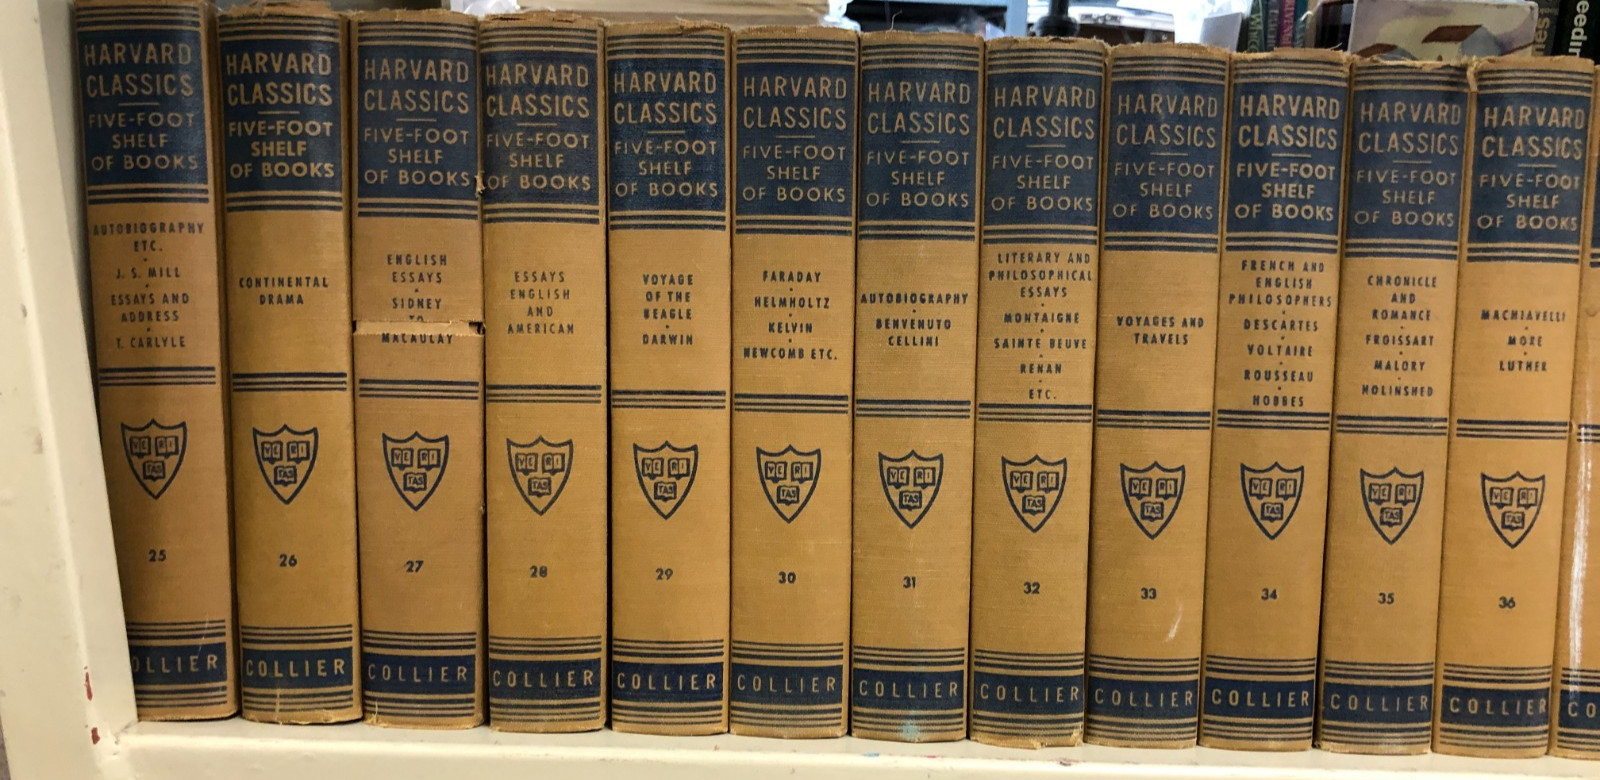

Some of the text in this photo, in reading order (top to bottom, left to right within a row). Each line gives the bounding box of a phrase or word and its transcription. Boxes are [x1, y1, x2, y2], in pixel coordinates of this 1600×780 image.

[85, 43, 192, 66] HARVARD
[227, 53, 331, 75] HARVARD
[366, 59, 468, 82] HARVARD
[487, 64, 588, 87] HARVARD
[615, 71, 716, 93] HARVARD
[87, 74, 194, 98] CLASSICS
[744, 76, 846, 98] HARVARD
[869, 81, 970, 104] HARVARD
[227, 82, 333, 106] CLASSICS
[365, 89, 469, 114] CLASSICS
[995, 86, 1095, 109] HARVARD
[487, 96, 589, 118] CLASSICS
[615, 102, 716, 125] CLASSICS
[1119, 94, 1217, 119] HARVARD
[1241, 94, 1339, 119] HARVARD
[1361, 101, 1460, 125] HARVARD
[744, 107, 846, 130] CLASSICS
[868, 112, 969, 135] CLASSICS
[1485, 107, 1584, 129] HARVARD
[994, 115, 1094, 140] CLASSICS
[365, 128, 469, 144] FIVE-FOOT
[1117, 124, 1216, 148] CLASSICS
[1239, 124, 1337, 150] CLASSICS
[252, 141, 306, 156] SHELF
[615, 140, 716, 155] FIVE-FOOT
[1359, 132, 1458, 156] CLASSICS
[1483, 136, 1582, 160] CLASSICS
[92, 154, 199, 171] OF BOOKS
[867, 150, 969, 165] FIVE-FOOT
[230, 162, 334, 178] OF BOOKS
[1357, 170, 1456, 185] FIVE-FOOT
[364, 170, 469, 186] OF BOOKS
[488, 175, 590, 191] OF BOOKS
[1018, 175, 1070, 189] SHELF
[616, 182, 717, 197] OF BOOKS
[743, 186, 845, 202] OF BOOKS
[1263, 183, 1314, 199] SHELF
[867, 192, 968, 207] OF BOOKS
[992, 196, 1092, 212] OF BOOKS
[1507, 194, 1558, 209] SHELF
[1113, 204, 1212, 220] OF BOOKS
[1235, 204, 1333, 221] OF BOOKS
[1354, 211, 1453, 227] OF BOOKS
[91, 222, 206, 237] AUTOBIOGRAPHY
[1477, 215, 1577, 231] OF BOOKS
[133, 240, 162, 252] ETC.
[386, 253, 447, 266] ENGLISH
[997, 251, 1090, 265] LITERARY AND
[147, 266, 182, 279] MILL
[1241, 259, 1325, 273] FRENCH AND
[238, 275, 329, 290] CONTINENTAL
[391, 271, 442, 284] ESSAYS
[513, 270, 565, 283] ESSAYS
[642, 273, 694, 286] VOYAGE
[762, 269, 821, 283] FARADAY
[988, 269, 1092, 282] PHILOSOPHICAL
[1255, 276, 1312, 290] ENGLISH
[1367, 274, 1437, 288] CHRONICLE
[110, 292, 190, 307] ESSAYS AND
[258, 293, 304, 306] DRAMA
[509, 288, 570, 300] ENGLISH
[646, 290, 691, 303] OF THE
[860, 292, 969, 305] AUTOBIOGRAPHY
[1019, 285, 1067, 299] ESSAYS
[1390, 292, 1416, 305] AND
[391, 297, 442, 310] SIDNEY
[754, 296, 830, 309] HELMHOLTZ
[1228, 292, 1331, 308] PHILOSOPHERS
[120, 309, 179, 324] ADDRESS
[527, 305, 554, 318] AND
[643, 308, 692, 320] BEAGLE
[1003, 311, 1080, 324] MONTAIGNE
[1371, 308, 1431, 321] ROMANCE
[1480, 308, 1566, 323] MACHIAVELLI
[507, 322, 574, 335] AMERICAN
[768, 321, 813, 334] KELVIN
[875, 317, 951, 330] BENVENUTO
[1116, 315, 1204, 329] VOYAGES AND
[1243, 317, 1318, 332] DESCARTES
[129, 334, 187, 350] CARLYLE
[381, 333, 452, 344] MACAULAY
[642, 333, 693, 346] DARWIN
[887, 335, 939, 347] CELLINI
[993, 337, 1087, 350] SAINTE BEUVE
[1133, 332, 1188, 346] TRAVELS
[1365, 333, 1434, 346] FROISSART
[1507, 335, 1543, 347] MORE
[743, 346, 837, 360] NEWCOMB ETC.
[1246, 343, 1313, 357] VOLTAIRE
[1019, 363, 1062, 374] RENAN
[1373, 359, 1425, 372] MALORY
[1499, 359, 1547, 372] LUTHER
[1243, 368, 1313, 383] ROUSSEAU
[1029, 389, 1056, 399] ETC.
[1361, 384, 1434, 397] HOLINSHED
[1252, 394, 1304, 408] HOBBES
[149, 549, 166, 562] 25
[280, 554, 297, 567] 26
[406, 560, 423, 572] 27
[530, 566, 547, 578] 28
[656, 568, 673, 580] 29
[779, 572, 796, 584] 30
[903, 576, 915, 588] 31
[1024, 582, 1040, 594] 32
[1141, 588, 1156, 599] 33
[1261, 588, 1277, 600] 34
[1378, 593, 1394, 604] 35
[1499, 597, 1515, 609] 36
[132, 655, 218, 673] OLLIER
[247, 659, 344, 677] COLLIER
[369, 664, 467, 682] COLLIER
[493, 670, 593, 687] COLLIER
[618, 673, 715, 690] COLLIER
[738, 675, 835, 693] COLLIER
[860, 680, 957, 698] COLLIER
[981, 684, 1079, 702] COLLIER
[1095, 689, 1193, 707] COLLIER
[1212, 689, 1309, 707] COLLIER
[1331, 694, 1428, 711] COLLIER
[1450, 697, 1546, 715] COLLIER
